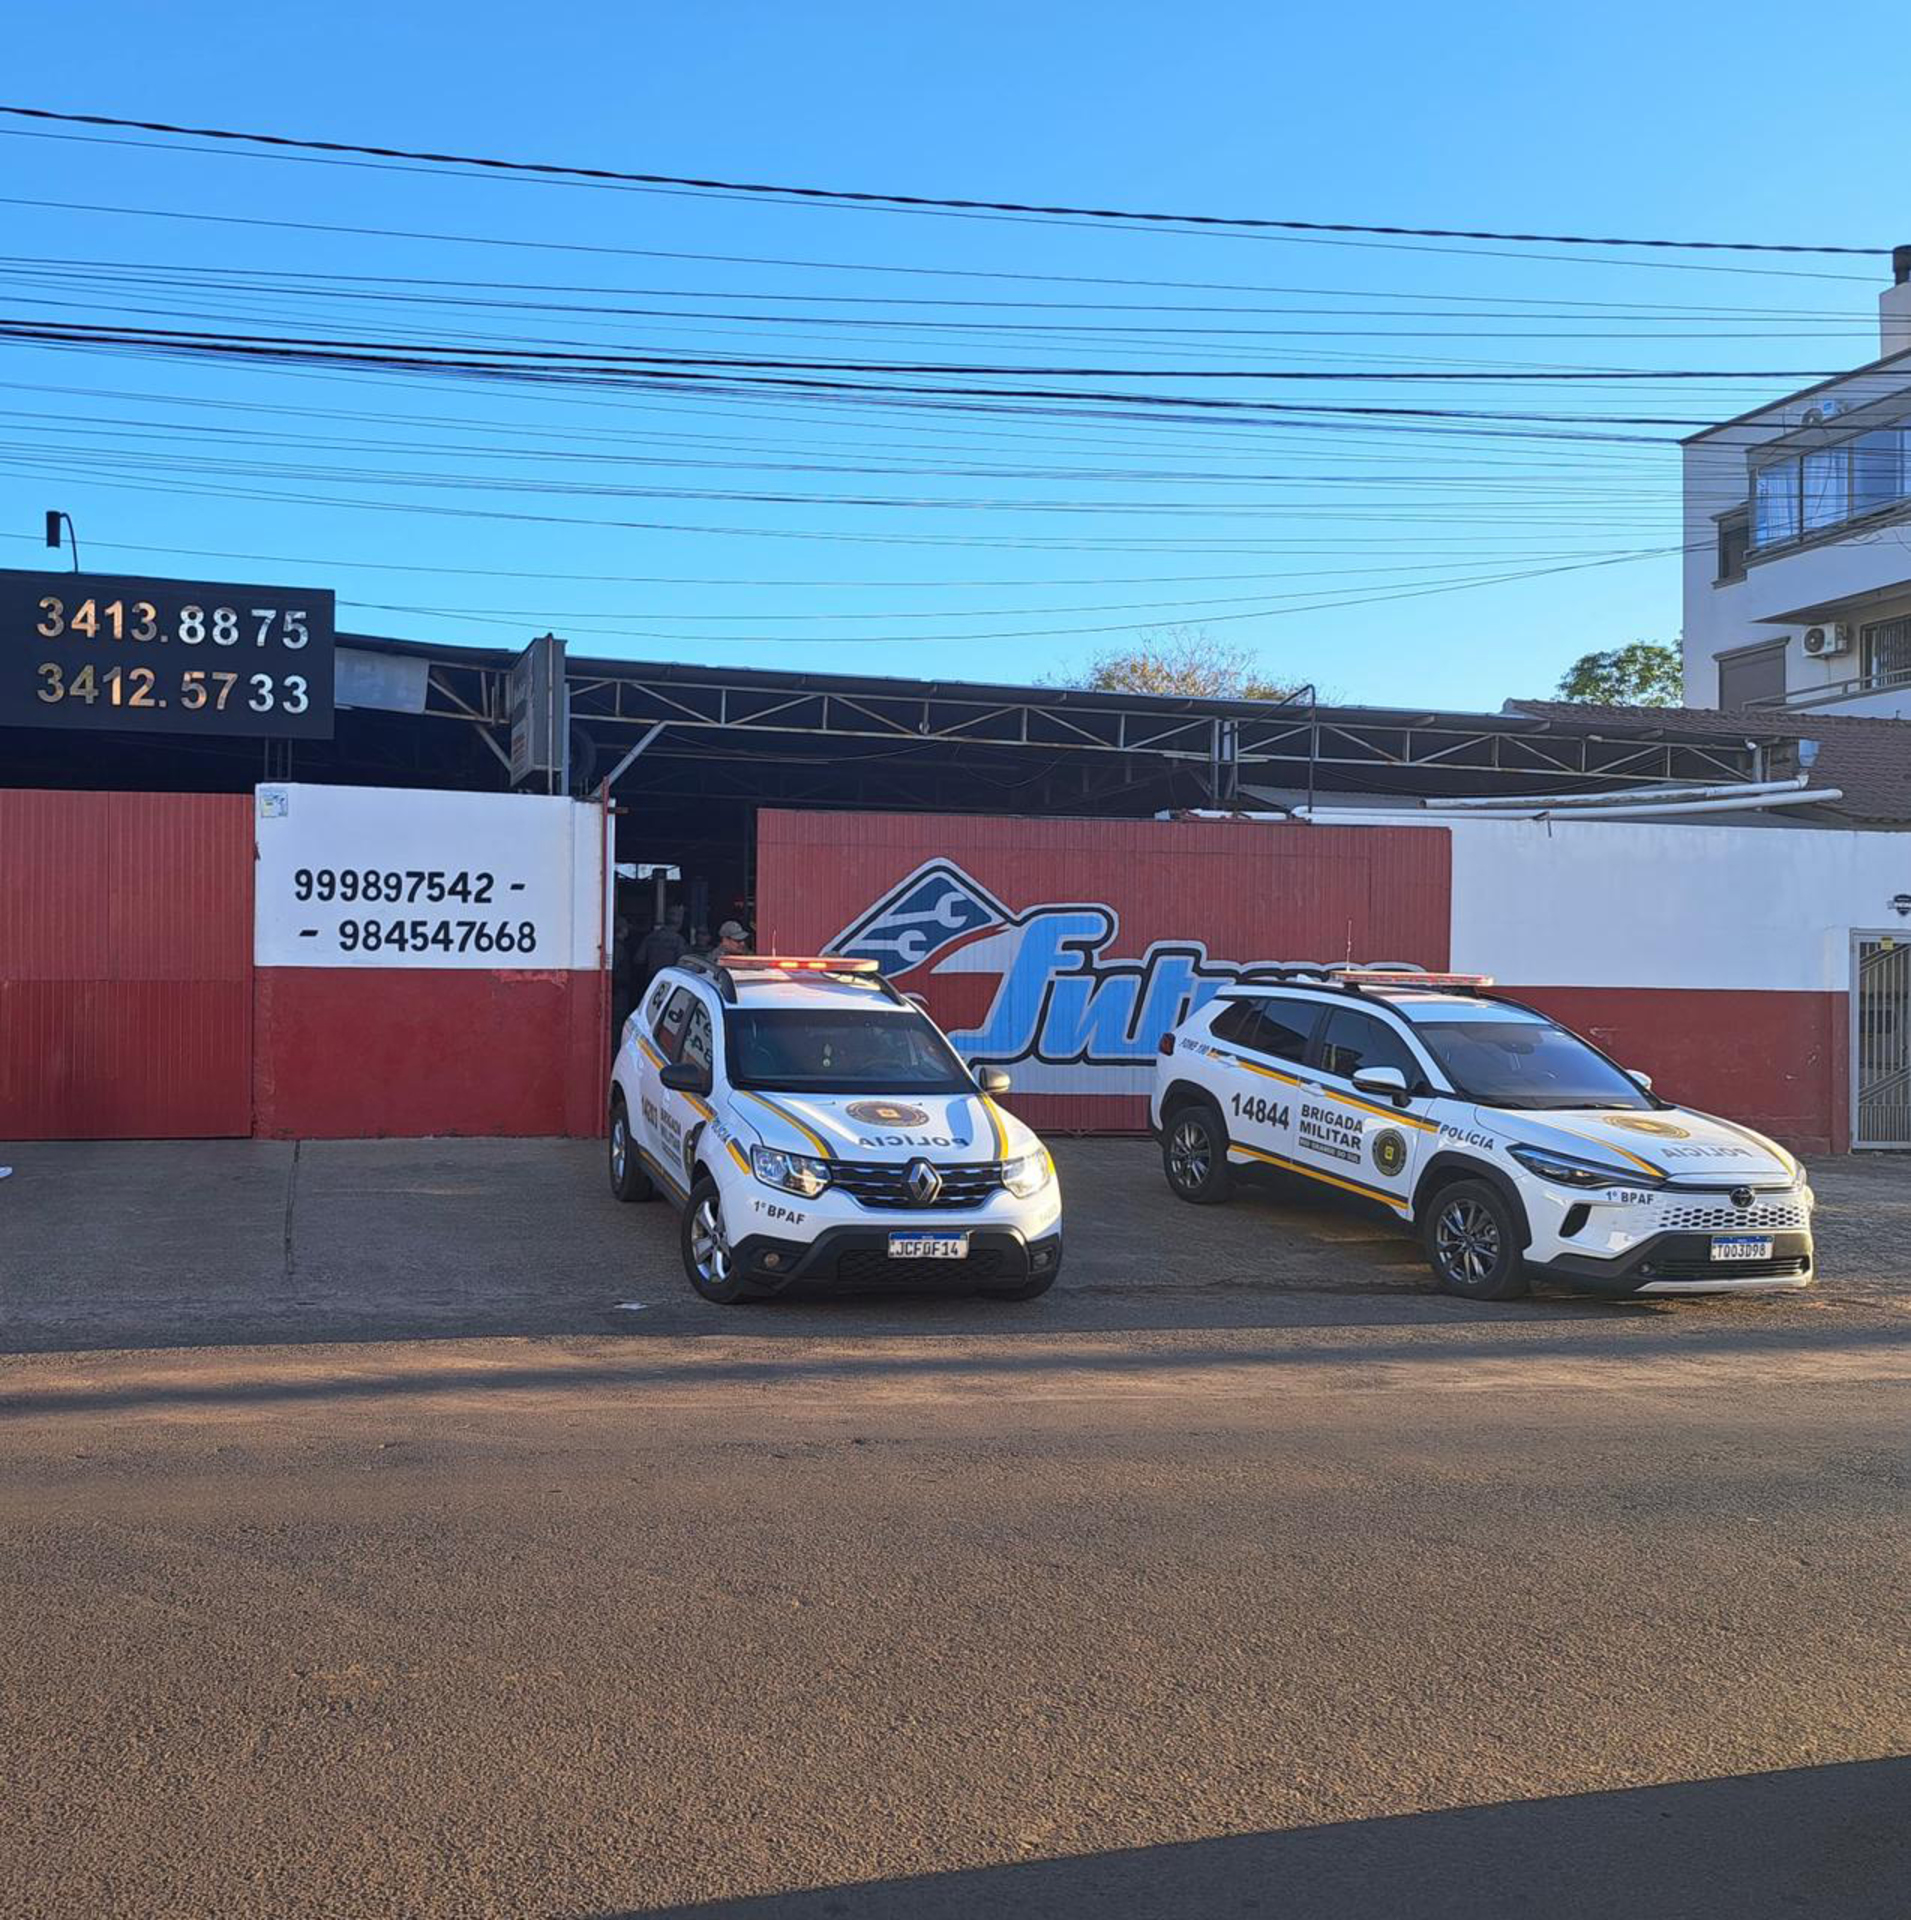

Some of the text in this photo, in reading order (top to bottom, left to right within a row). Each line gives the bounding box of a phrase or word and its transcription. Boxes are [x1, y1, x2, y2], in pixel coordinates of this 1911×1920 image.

[294, 869, 495, 903] 999897542
[338, 919, 537, 953] 984547668
[1231, 1092, 1290, 1131] 14844
[1301, 1103, 1363, 1134] BRIGADA
[1300, 1119, 1361, 1151] MILITAR
[1439, 1123, 1495, 1151] POLÍCIA
[1621, 1191, 1654, 1206] BPAF
[767, 1204, 805, 1225] BPAF
